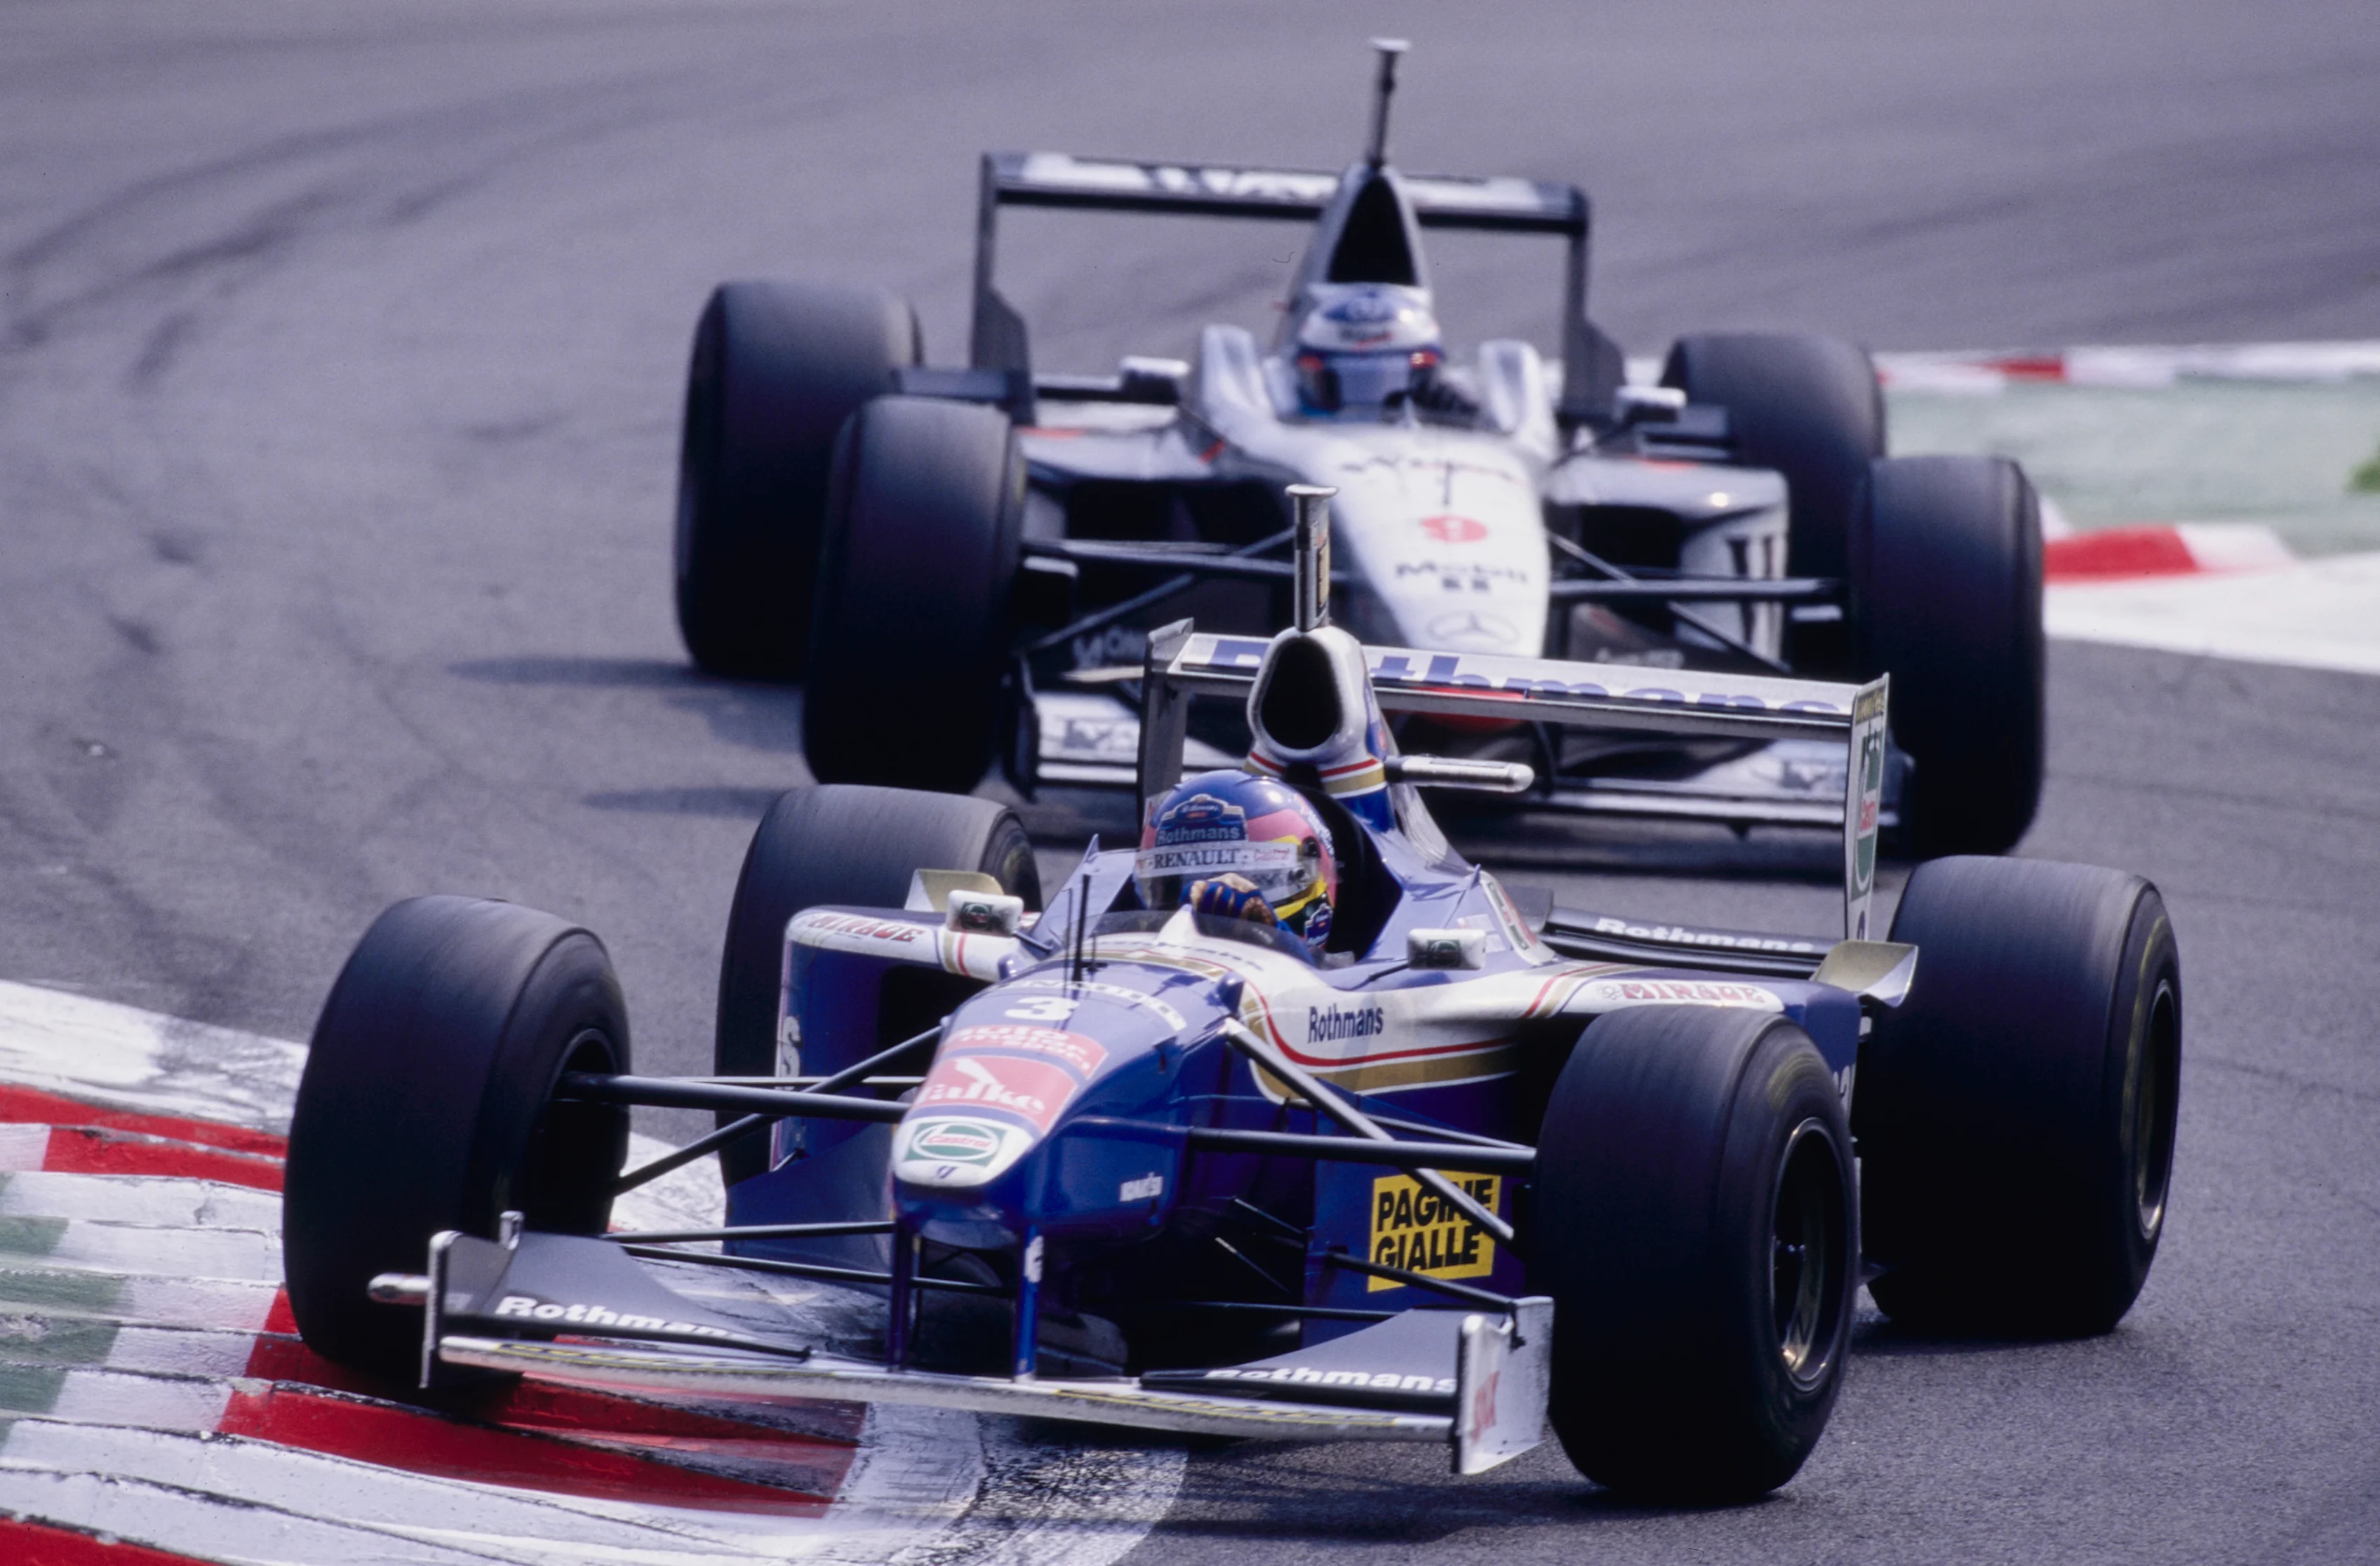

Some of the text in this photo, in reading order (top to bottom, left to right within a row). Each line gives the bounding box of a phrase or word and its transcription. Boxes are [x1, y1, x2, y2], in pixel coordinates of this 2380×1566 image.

[1208, 639, 1840, 713] thmans
[1157, 825, 1241, 845] Rothmans
[1154, 848, 1240, 869] RENAULT
[1595, 917, 1814, 952] Rothmans
[1005, 996, 1081, 1022] 3
[1307, 1003, 1384, 1043] Rothmans
[1376, 1226, 1480, 1271] GIALLE
